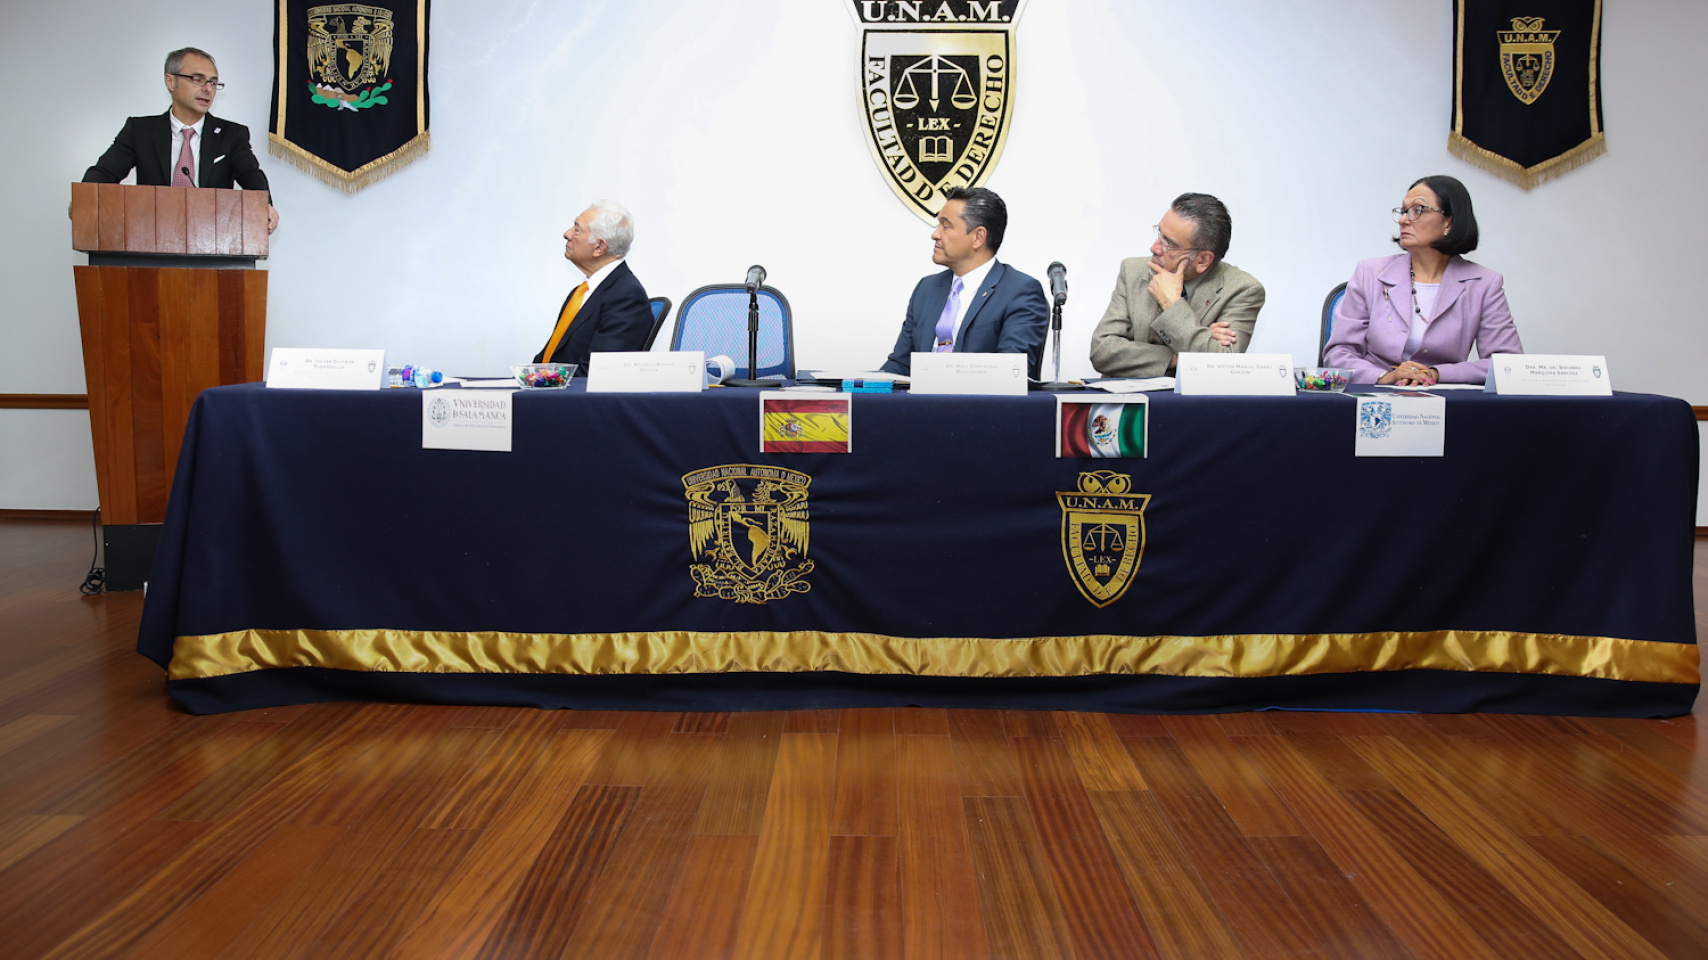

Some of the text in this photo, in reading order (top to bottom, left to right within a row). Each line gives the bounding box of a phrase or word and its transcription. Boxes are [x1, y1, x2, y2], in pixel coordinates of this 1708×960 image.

[861, 0, 1011, 22] U.N.A.M.
[1504, 33, 1552, 43] U.N.A.M.
[868, 54, 917, 184] FACULTAD
[954, 54, 1004, 184] DERECHO
[918, 117, 950, 131] LEX
[1065, 496, 1140, 510] U.N.A.M.
[1070, 523, 1092, 583] FACULTAD
[1116, 525, 1137, 583] DERECHO
